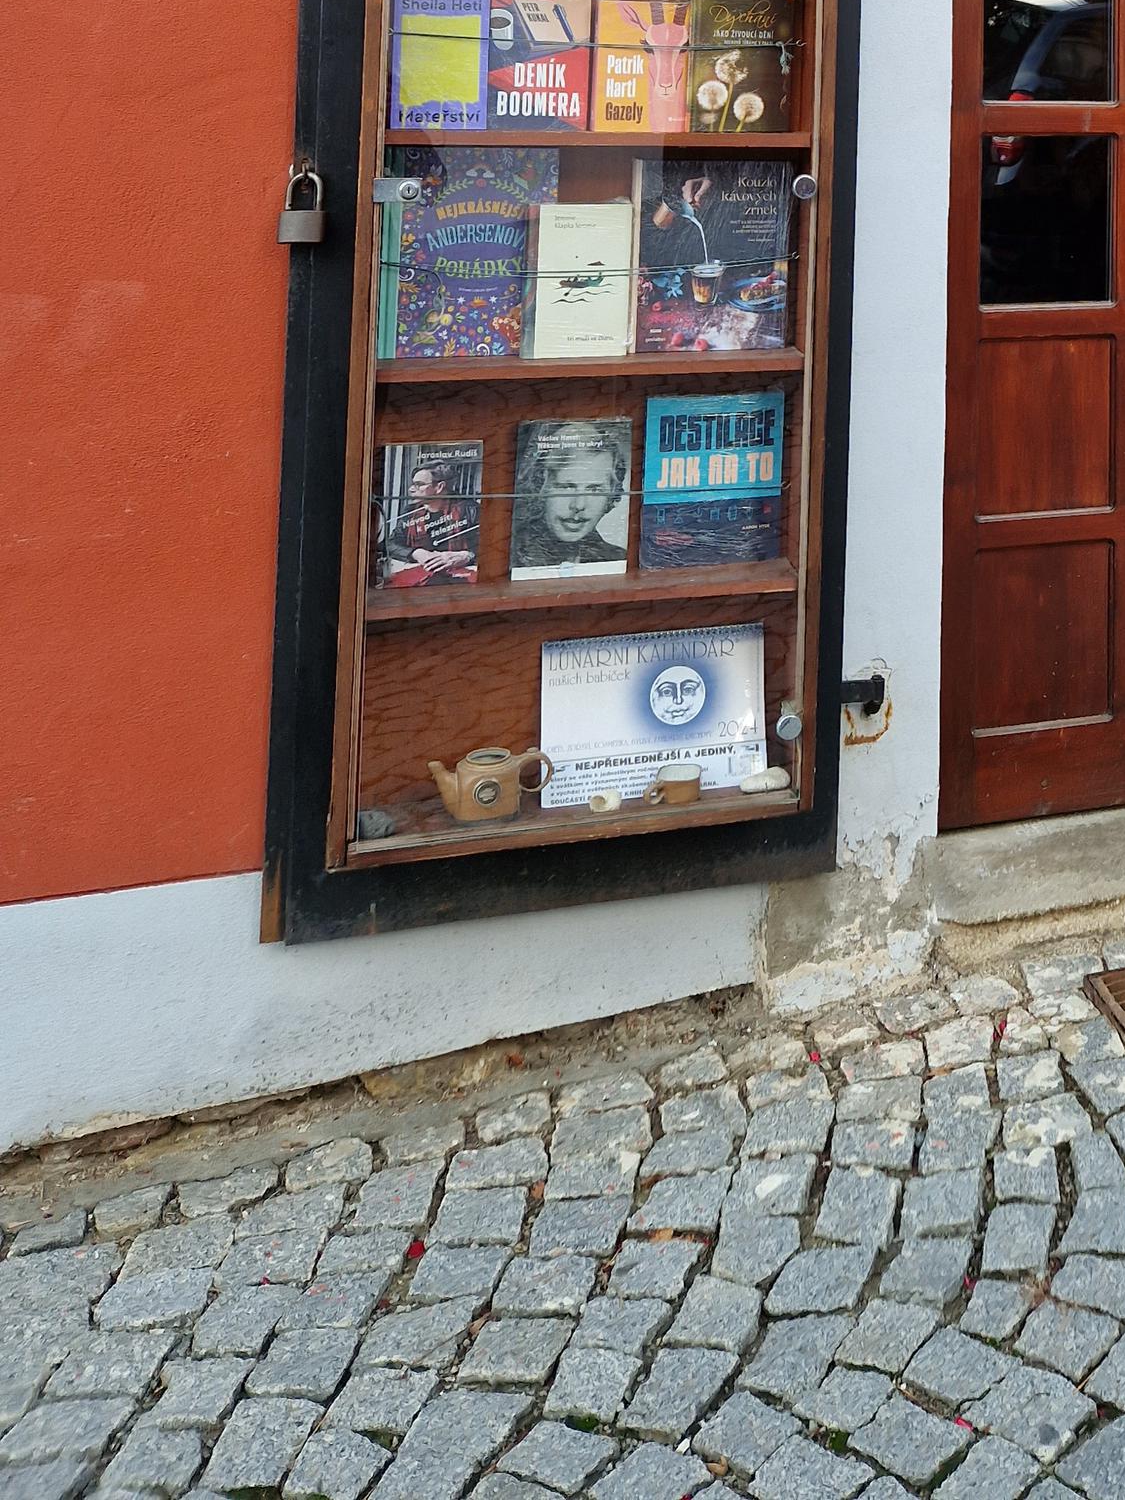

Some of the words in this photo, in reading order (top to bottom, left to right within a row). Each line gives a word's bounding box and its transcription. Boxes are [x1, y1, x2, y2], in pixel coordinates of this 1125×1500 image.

[402, 0, 446, 11] Sheila
[452, 0, 482, 11] Heti
[521, 2, 539, 12] PETR
[527, 12, 550, 23] KUKAL
[713, 30, 730, 38] JAKO
[514, 58, 567, 88] DENÍK
[607, 54, 645, 75] Patrik
[606, 78, 637, 98] Hartl
[496, 91, 581, 117] BOOMERA
[605, 101, 643, 124] Gazely
[399, 110, 480, 123] Mateřství
[738, 177, 777, 188] Kouzlo
[721, 190, 777, 205] kávových
[744, 205, 777, 215] zrnek
[434, 256, 522, 279] POHÁDKY
[659, 408, 775, 453] DESTILACE
[418, 451, 454, 459] Jaroslav
[455, 449, 477, 457] Rudiš
[656, 456, 700, 489] JAK
[708, 453, 739, 485] NA
[746, 451, 774, 483] TO
[403, 512, 430, 529] Návod
[424, 514, 453, 531] použití
[431, 519, 468, 537] železnice
[549, 674, 582, 687] našich
[586, 669, 631, 684] babiček
[718, 720, 758, 737] 2024
[575, 750, 681, 771] NEJPŘEHLEDNĚJŠÍ
[684, 751, 691, 759] A
[694, 744, 736, 758] JEDINÝ,
